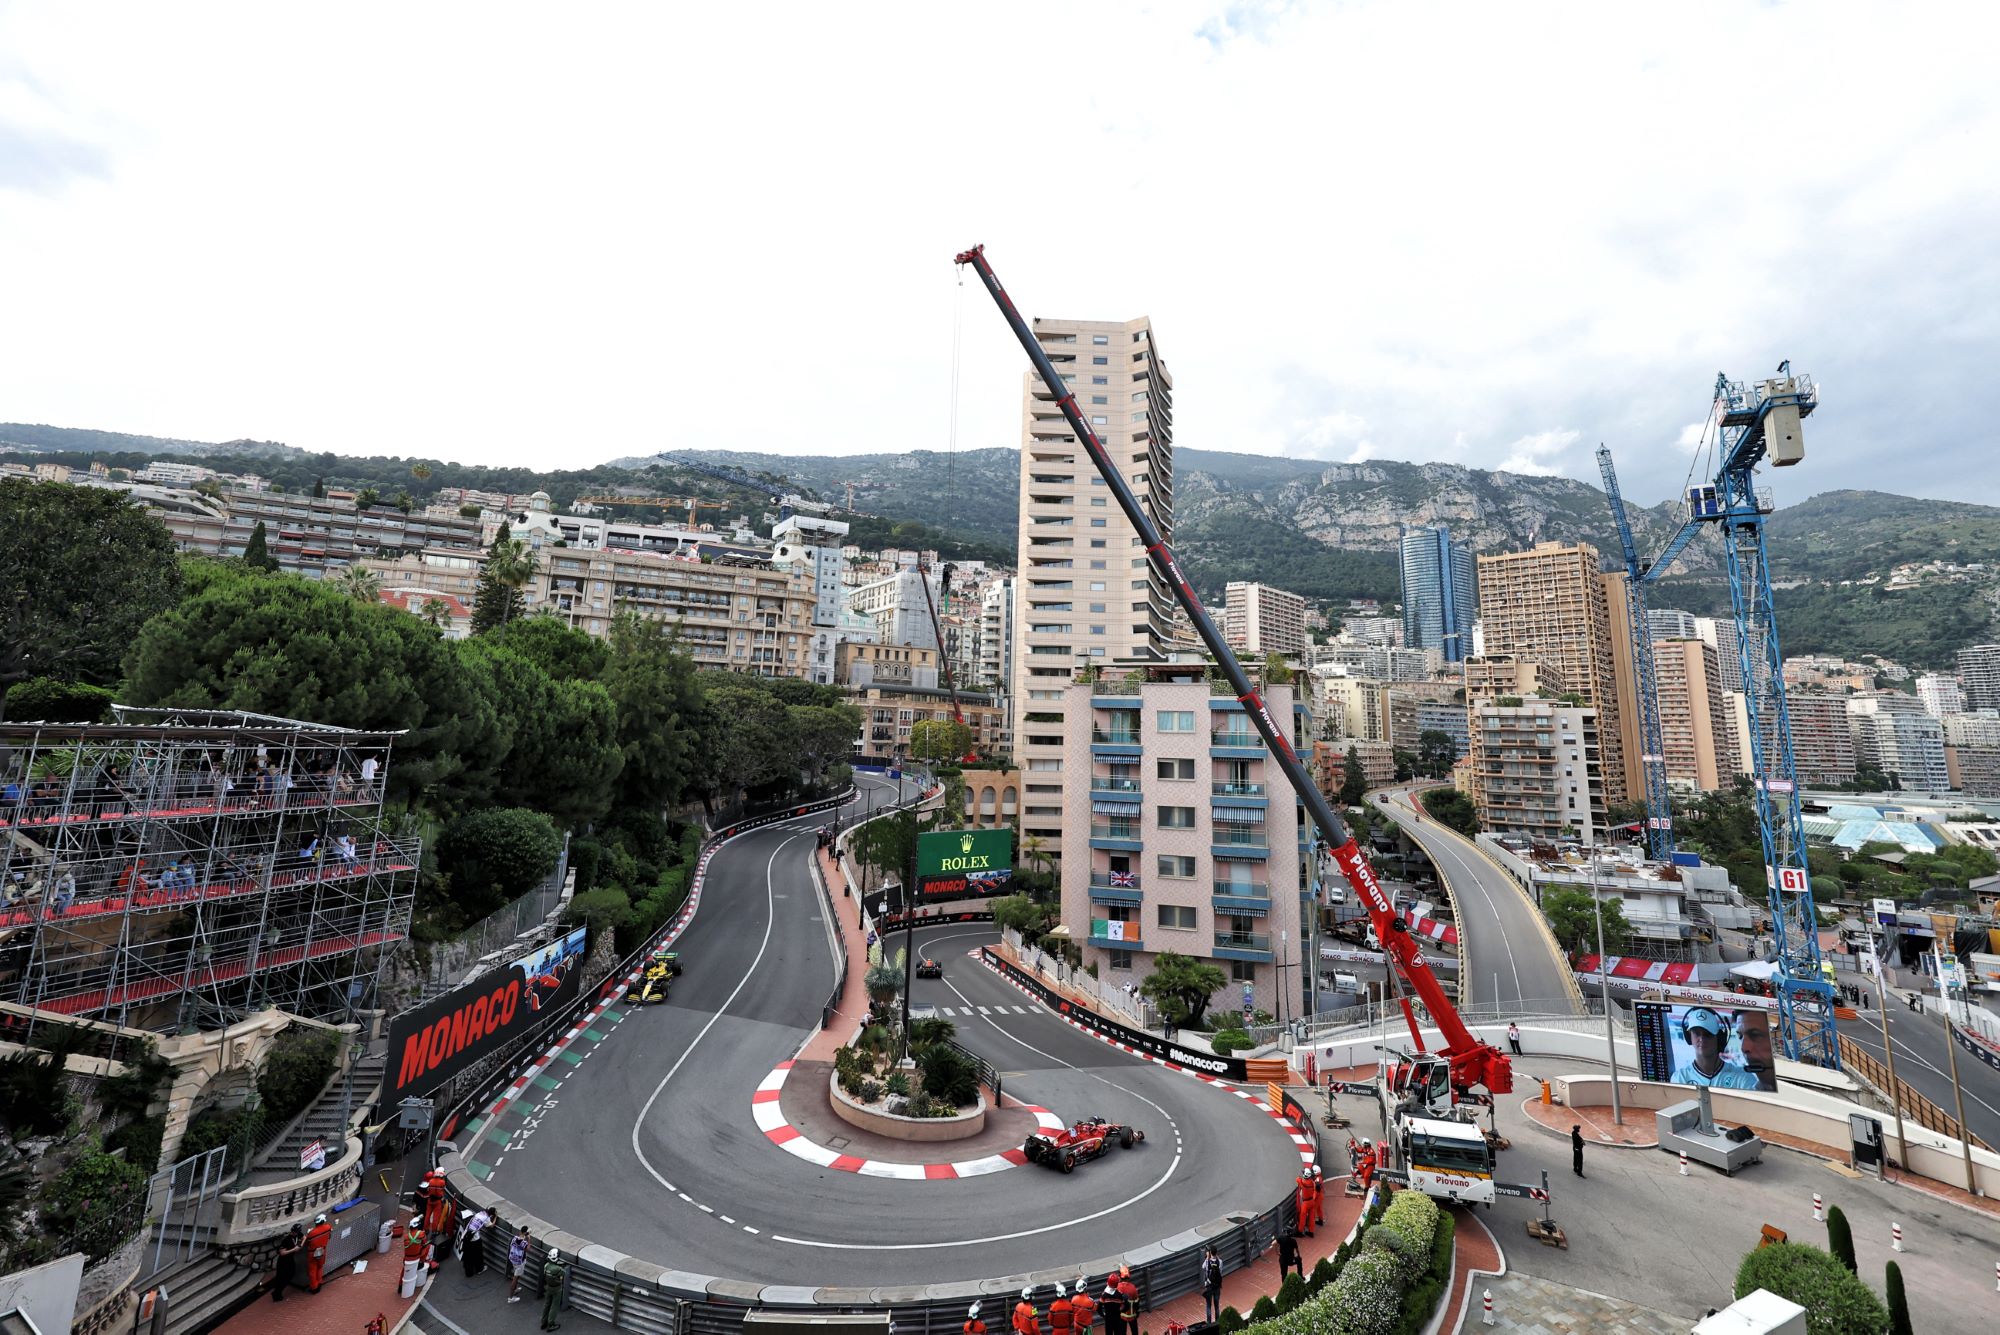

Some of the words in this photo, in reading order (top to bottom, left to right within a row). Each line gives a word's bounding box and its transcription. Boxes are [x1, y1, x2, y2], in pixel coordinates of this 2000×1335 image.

[1260, 707, 1280, 737] Piovano
[941, 855, 990, 871] ROLEX
[923, 879, 967, 894] MONACO
[1349, 853, 1389, 913] Piovano
[1783, 870, 1805, 889] G1
[1350, 955, 1375, 964] MONACO
[1680, 991, 1713, 1000] MONACO
[1723, 997, 1757, 1006] MONACO
[397, 979, 520, 1090] MONACO
[1169, 1048, 1228, 1073] #MonacoGP
[1347, 1087, 1372, 1095] Piovano
[511, 1100, 559, 1150] TAXIS
[1436, 1175, 1470, 1187] Piovano
[1495, 1186, 1521, 1196] iovano
